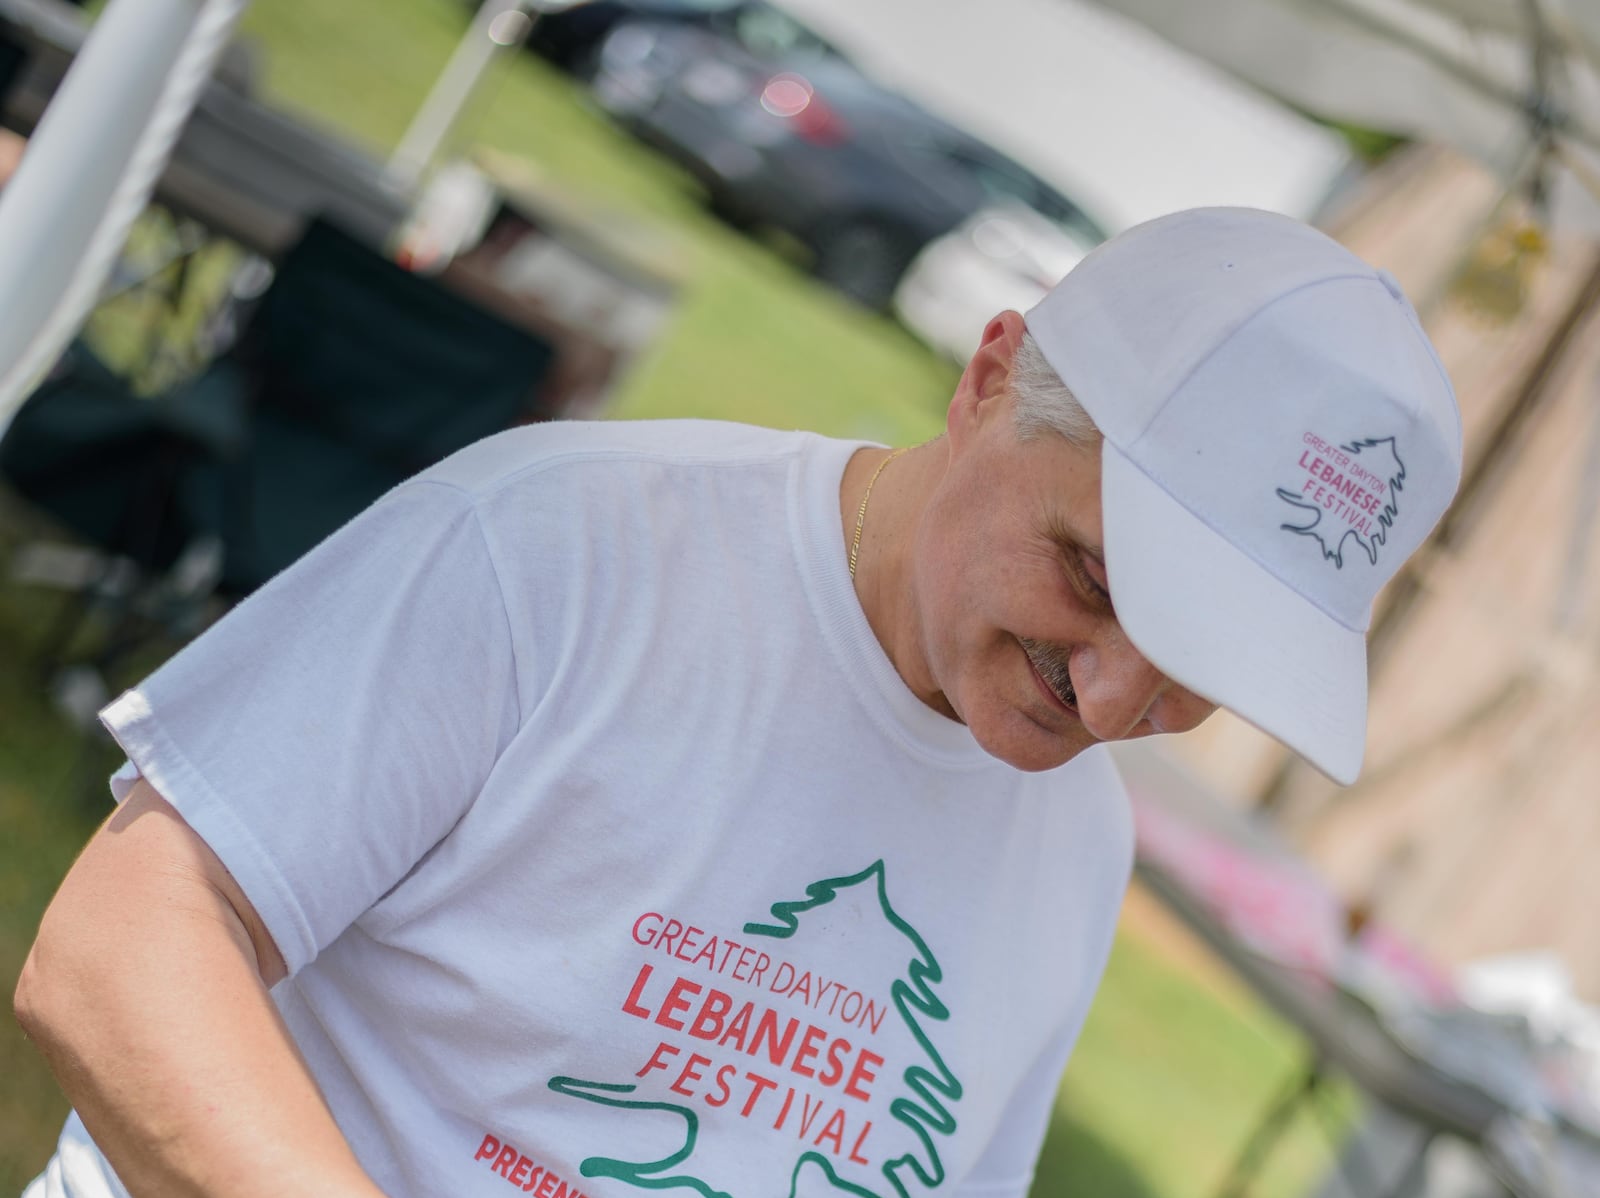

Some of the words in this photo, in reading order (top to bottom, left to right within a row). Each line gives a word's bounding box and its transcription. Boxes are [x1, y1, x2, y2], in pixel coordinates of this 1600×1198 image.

[1298, 450, 1382, 516] LEBANESE
[1302, 479, 1374, 537] FESTIVAL
[1303, 431, 1350, 468] GREATER
[1349, 463, 1388, 494] DAYTON
[631, 912, 770, 987] GREATER
[769, 961, 887, 1035] DAYTON
[621, 963, 885, 1102] LEBANESE
[635, 1042, 876, 1166] FESTIVAL
